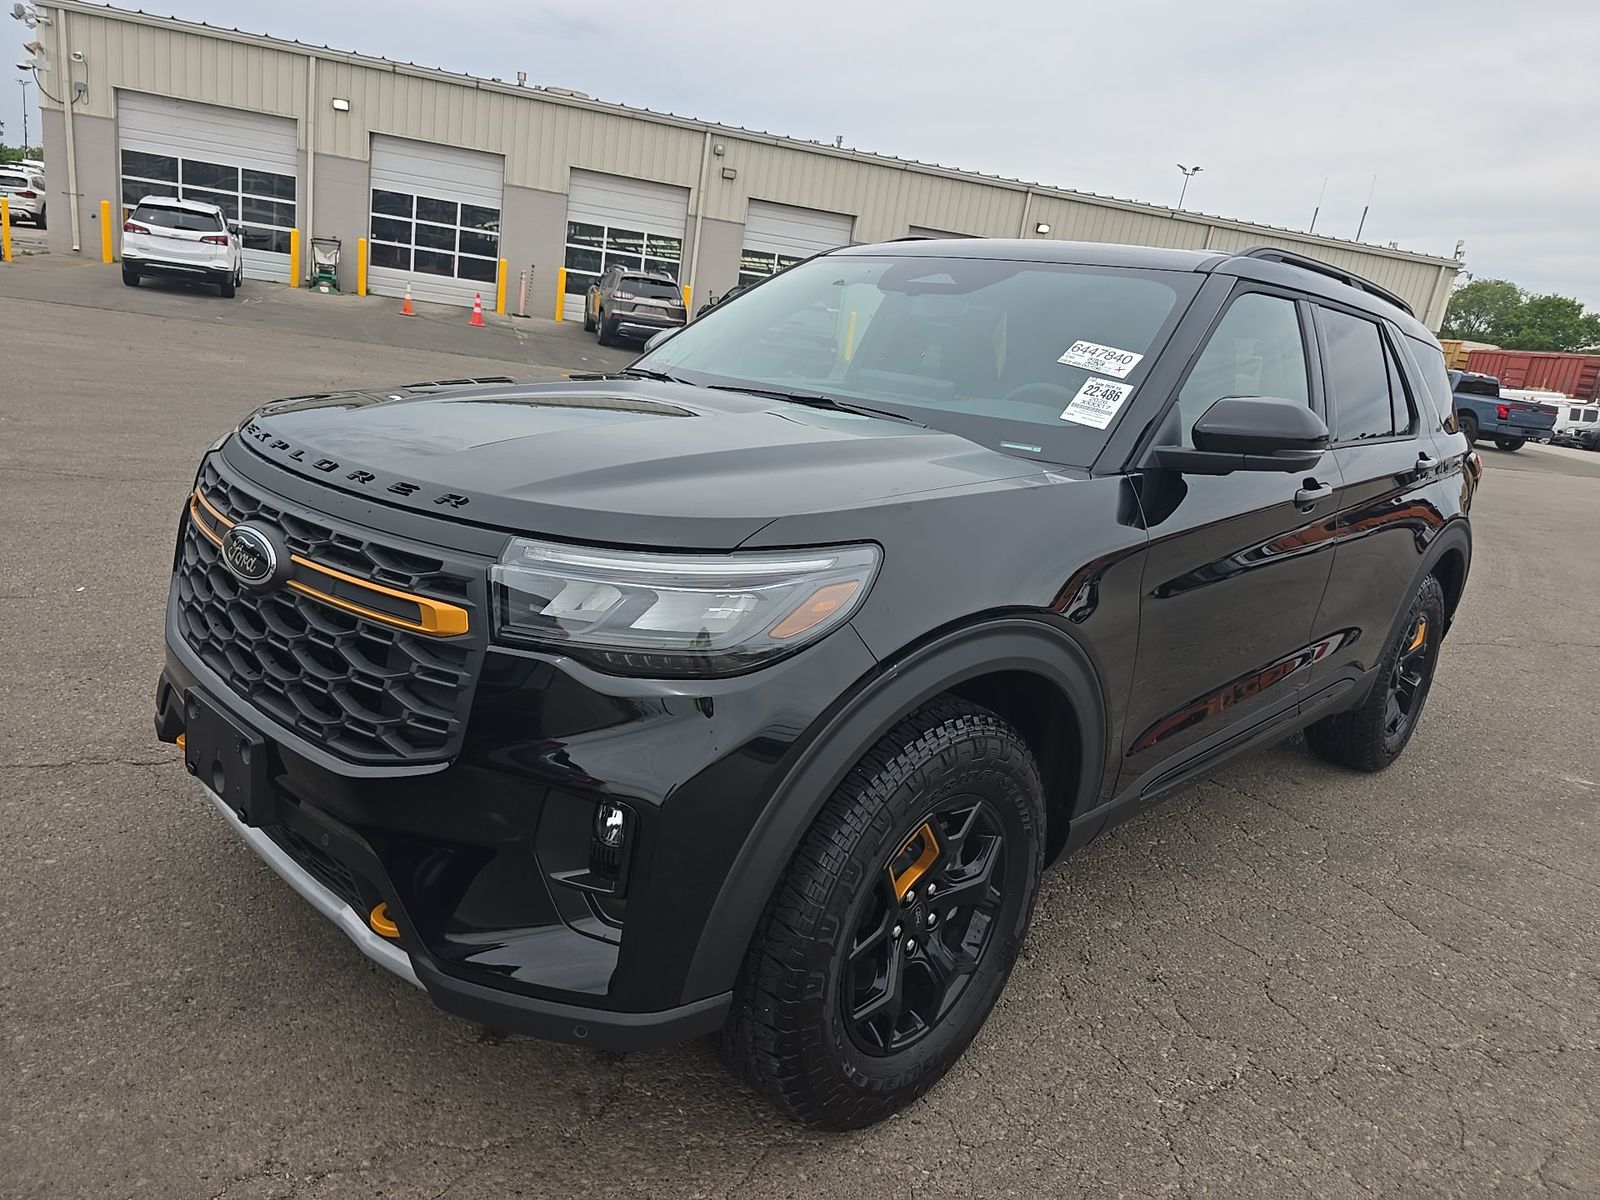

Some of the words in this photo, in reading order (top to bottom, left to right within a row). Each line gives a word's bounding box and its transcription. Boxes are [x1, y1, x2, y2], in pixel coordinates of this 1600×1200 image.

[1071, 343, 1133, 365] 6447840
[1083, 384, 1122, 402] 22:486
[246, 423, 470, 509] EXPLORER
[228, 535, 260, 573] Ford
